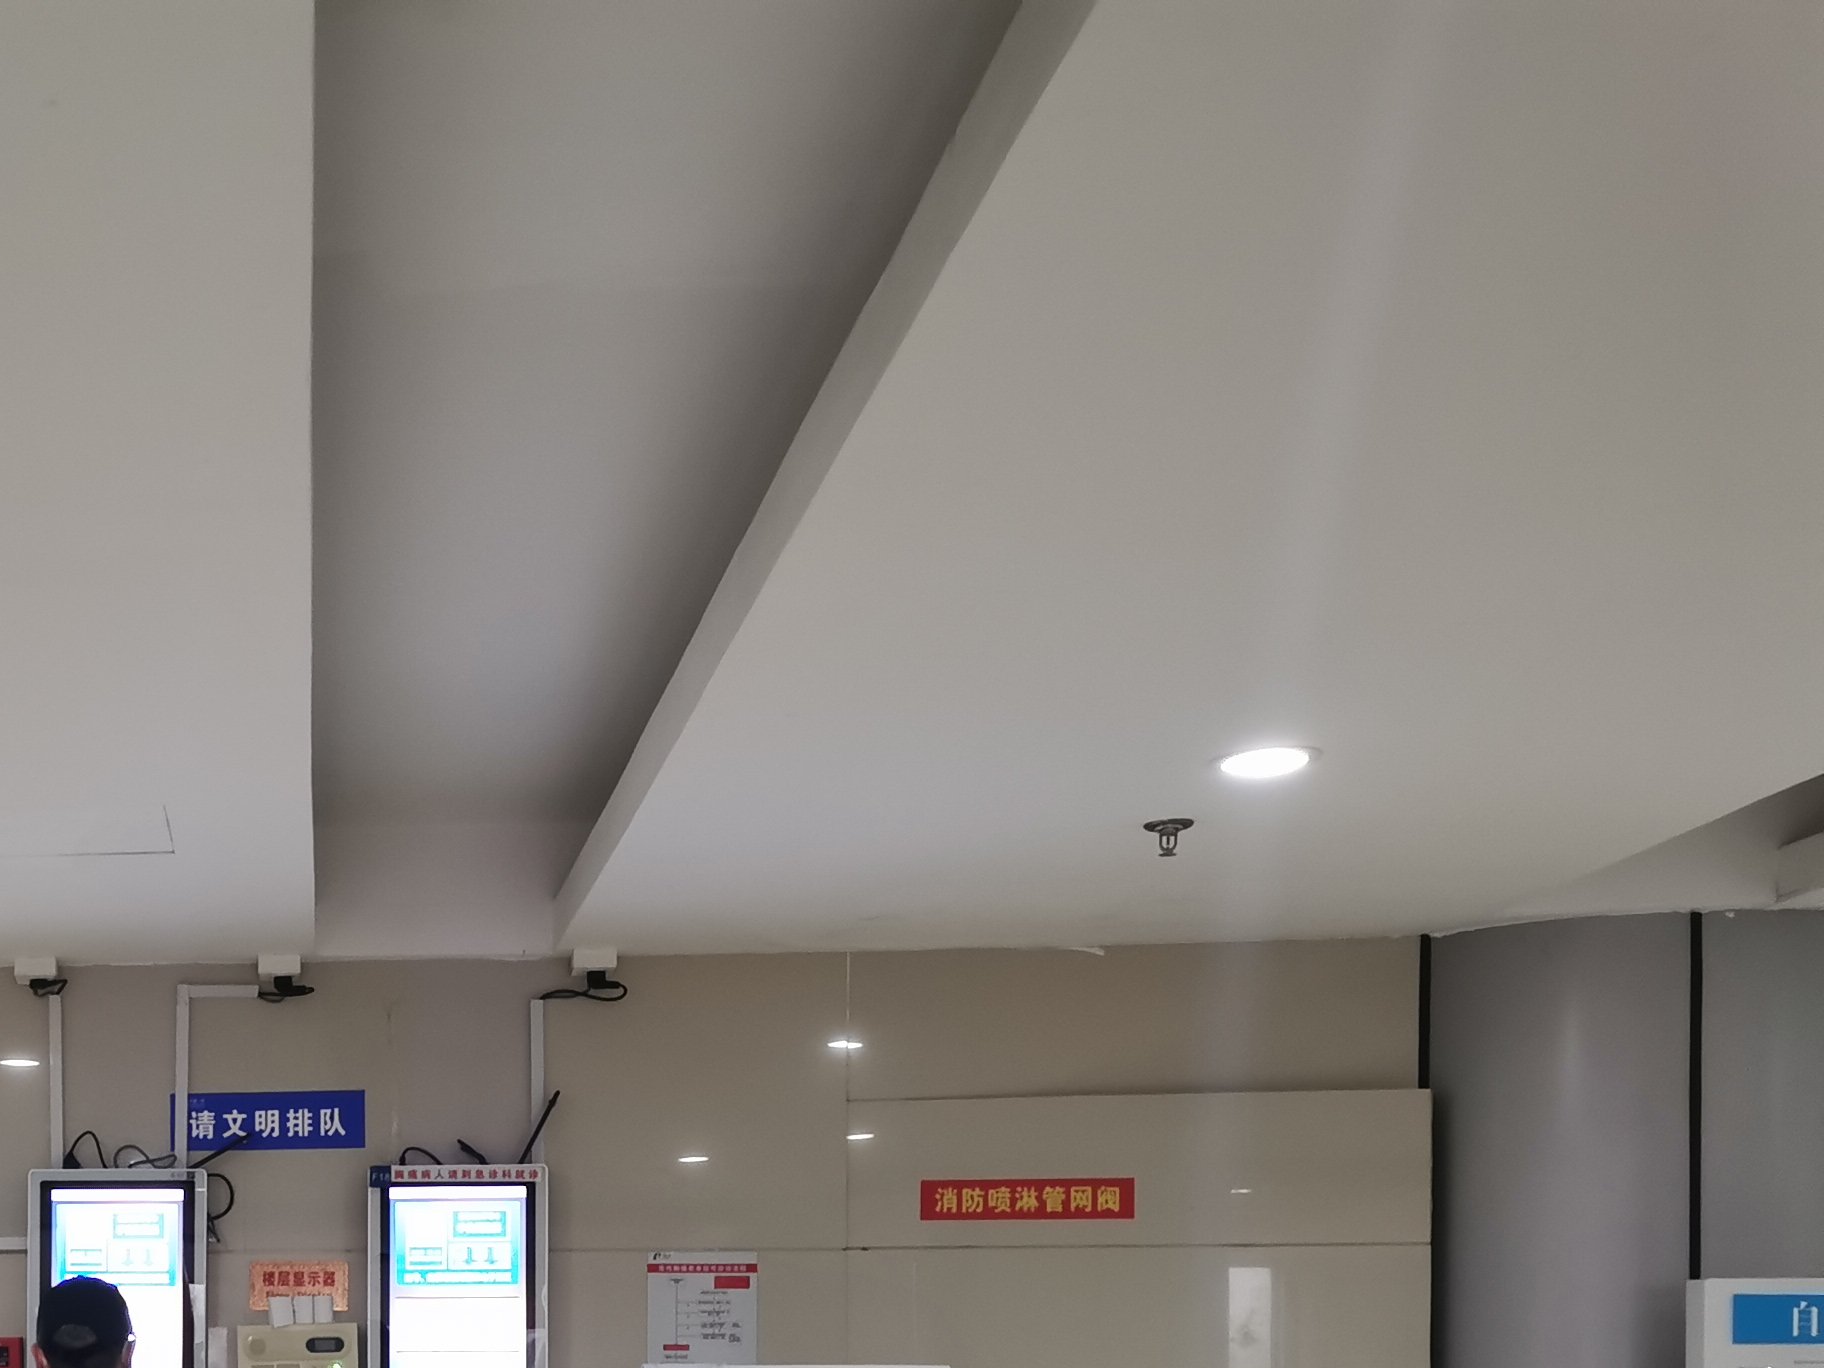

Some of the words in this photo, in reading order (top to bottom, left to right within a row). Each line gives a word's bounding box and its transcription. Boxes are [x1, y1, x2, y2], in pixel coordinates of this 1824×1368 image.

[189, 1108, 346, 1139] 请文明排队
[262, 1270, 336, 1287] 楼层显示器
